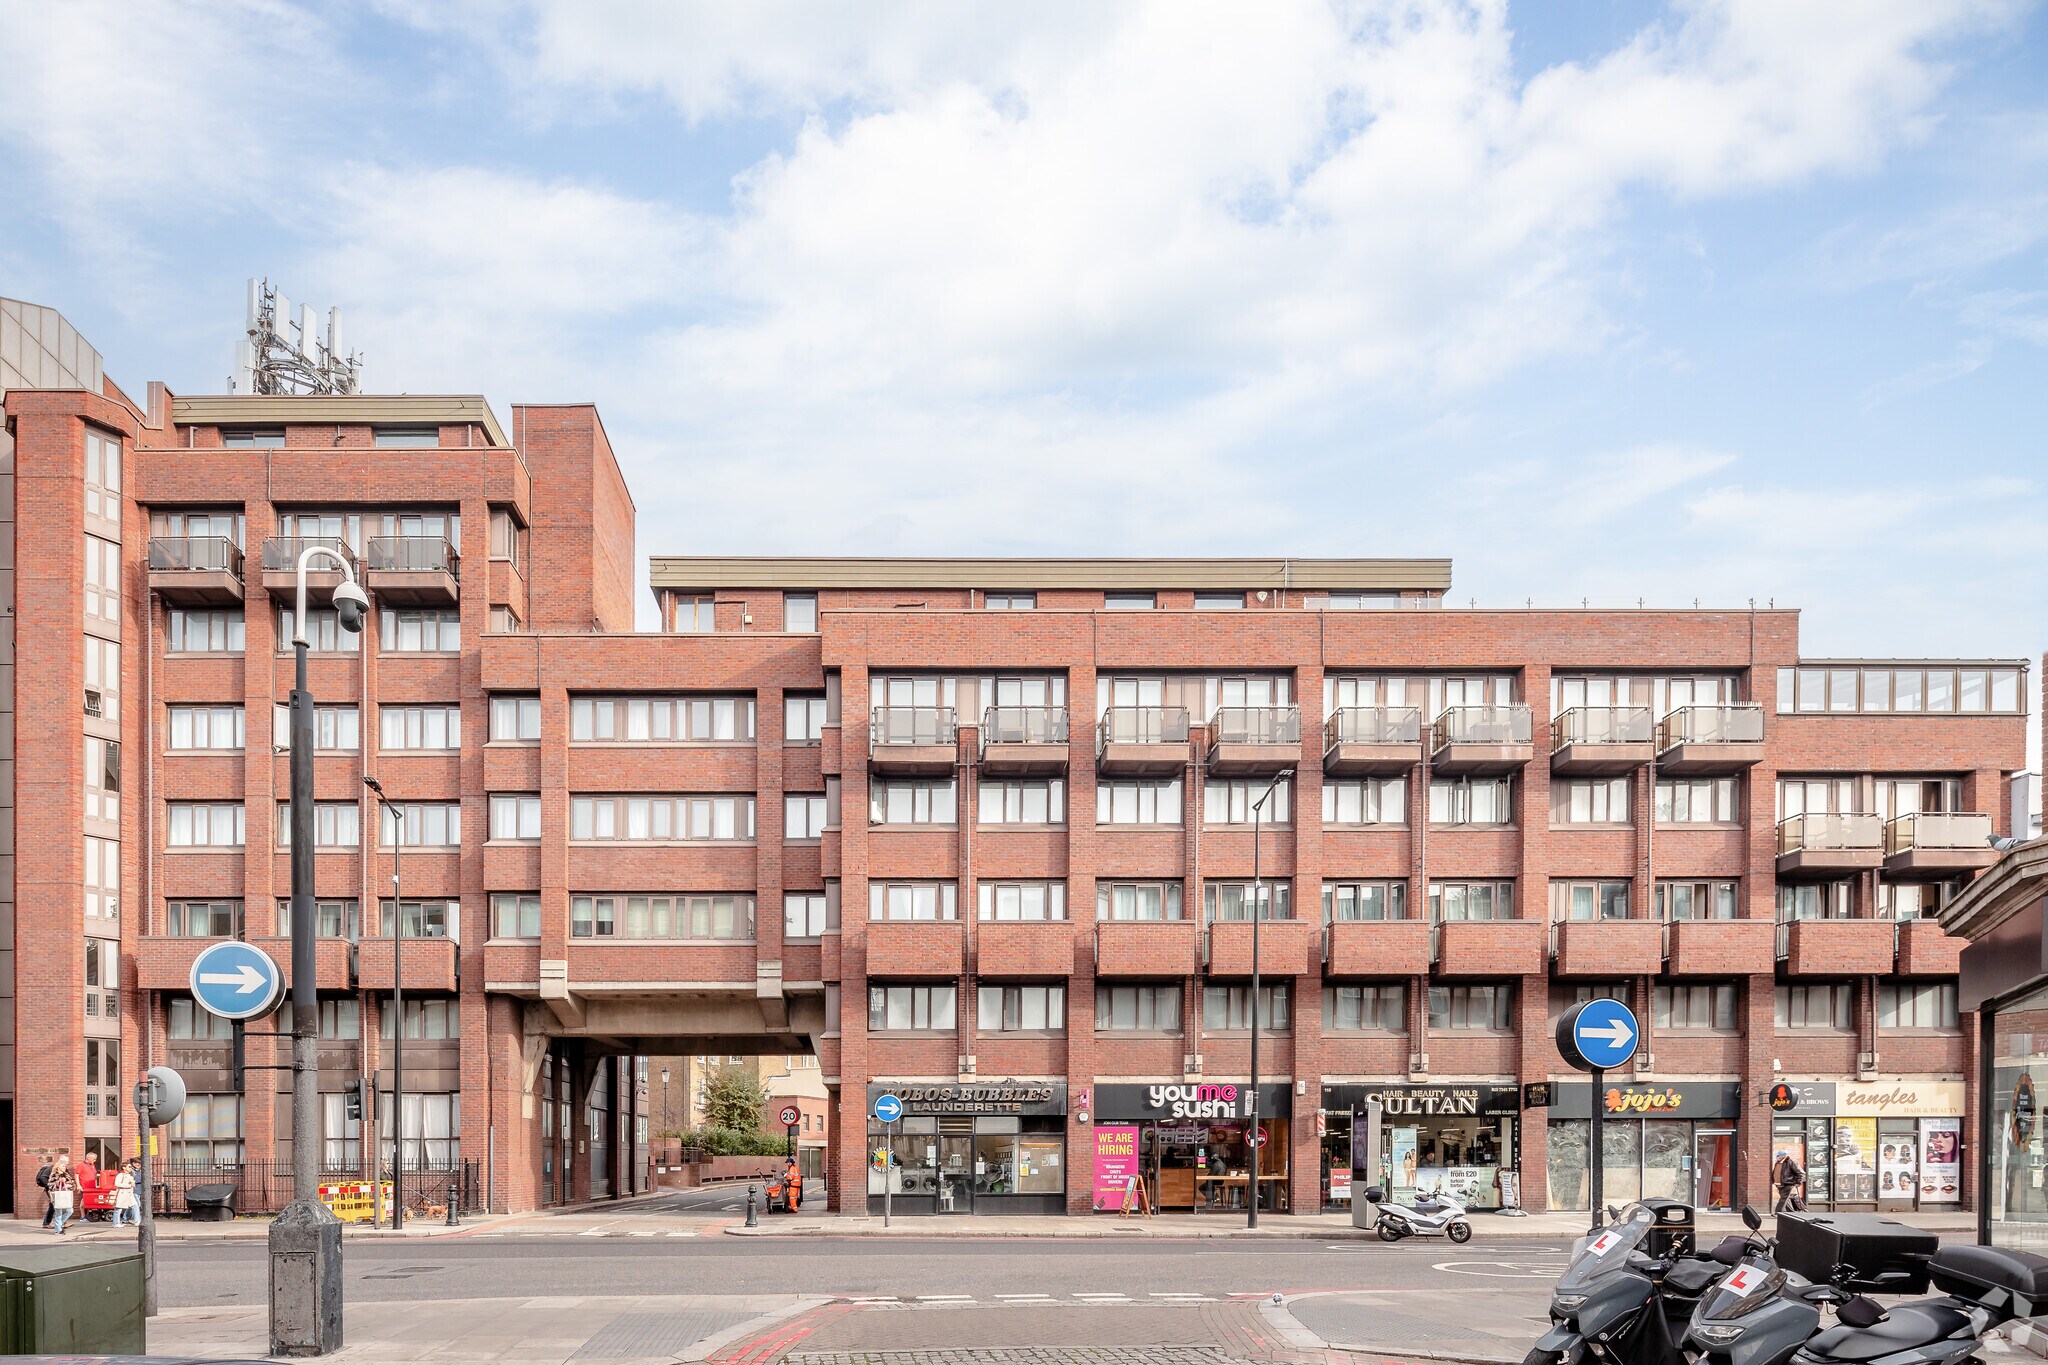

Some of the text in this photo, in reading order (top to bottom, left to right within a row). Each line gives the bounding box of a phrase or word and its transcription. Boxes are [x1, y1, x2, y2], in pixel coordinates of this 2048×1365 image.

[1383, 1090, 1404, 1098] HAIR
[1411, 1090, 1446, 1098] BEAUTY
[1615, 1088, 1682, 1112] jojo's
[1845, 1087, 1918, 1111] tangles
[912, 1102, 1022, 1112] LAUNDERETTE
[1171, 1098, 1236, 1118] sushi
[782, 1112, 795, 1120] 20
[1098, 1133, 1133, 1143] WE ARE
[1098, 1144, 1134, 1155] HIRING
[1594, 1235, 1609, 1250] L
[1729, 1270, 1748, 1290] L
